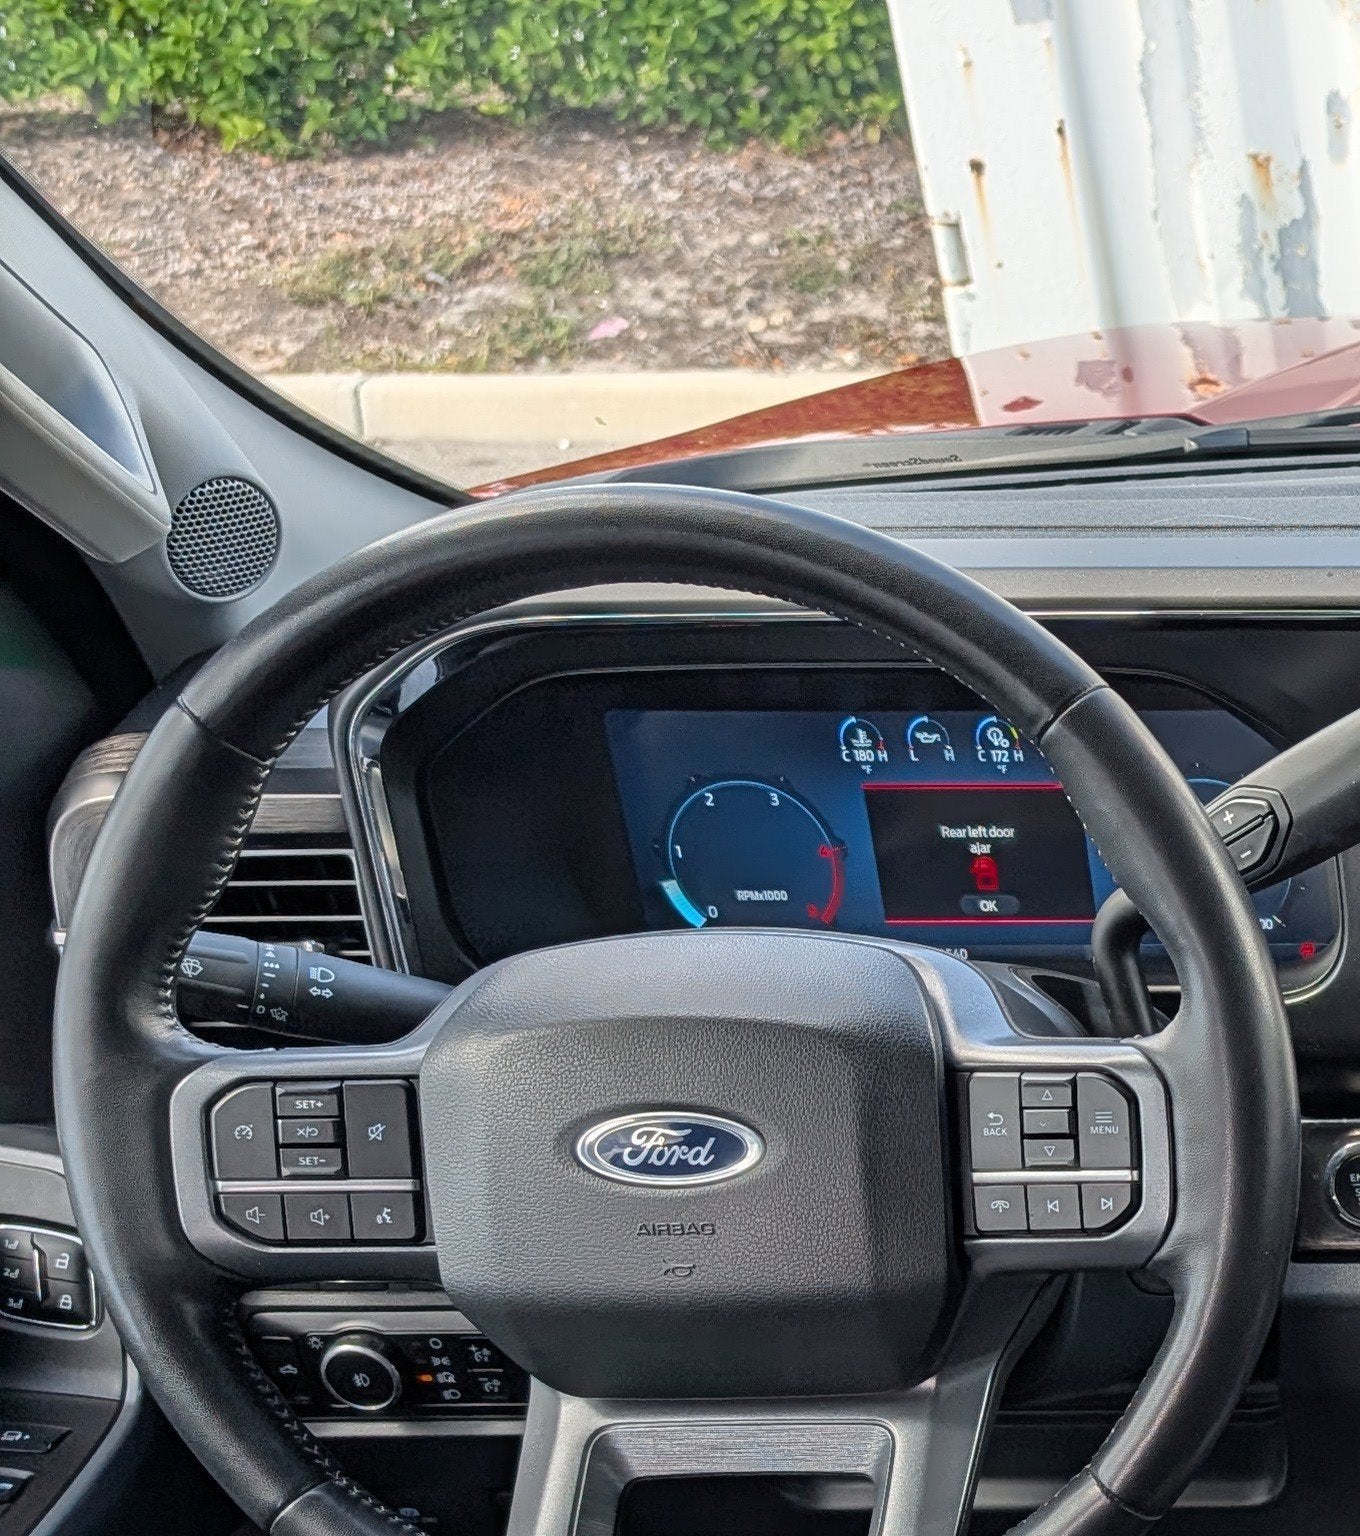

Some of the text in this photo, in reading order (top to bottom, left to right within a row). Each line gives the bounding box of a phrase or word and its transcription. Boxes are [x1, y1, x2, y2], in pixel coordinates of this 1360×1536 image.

[854, 751, 875, 762] 180
[878, 751, 888, 762] H
[944, 751, 956, 762] H
[991, 751, 1010, 763] 172
[1013, 751, 1024, 762] H
[704, 792, 715, 807] 2
[769, 792, 780, 807] 3
[941, 826, 1015, 838] Rear left door
[675, 845, 683, 859] 1
[970, 843, 992, 855] ajar
[980, 899, 999, 912] OK
[708, 905, 719, 919] 0
[983, 1127, 1008, 1137] BACK
[1090, 1126, 1119, 1135] MENU
[623, 1127, 717, 1167] Ford
[637, 1222, 717, 1237] AIRBAG
